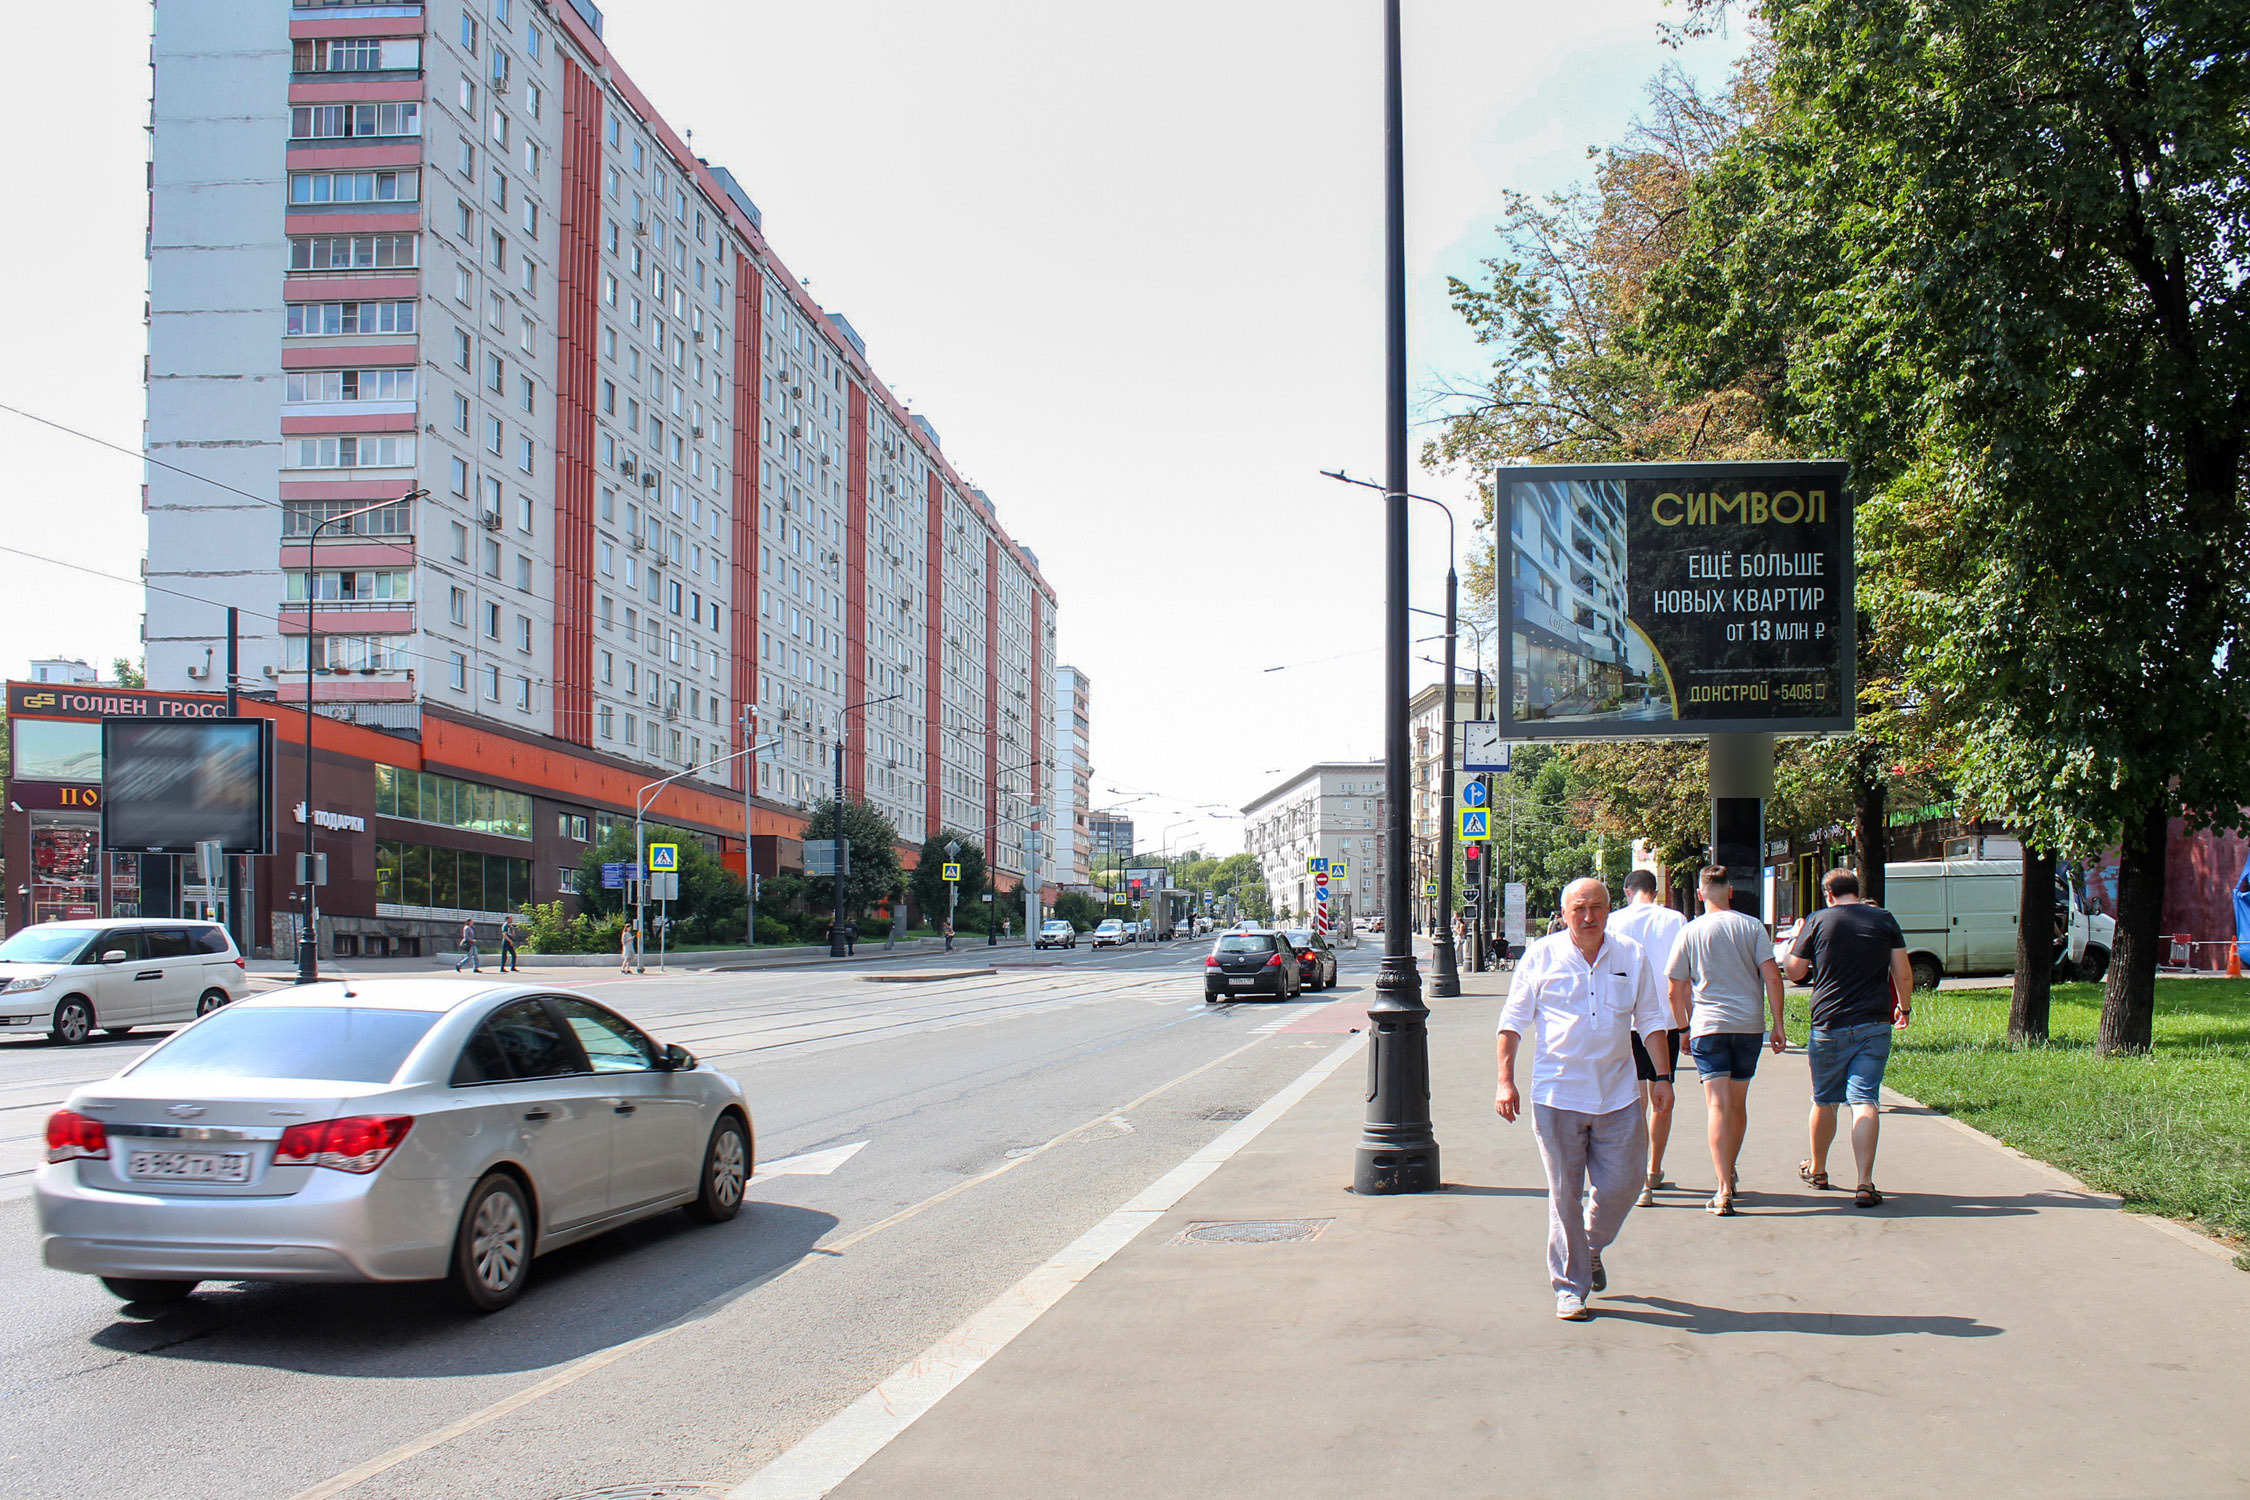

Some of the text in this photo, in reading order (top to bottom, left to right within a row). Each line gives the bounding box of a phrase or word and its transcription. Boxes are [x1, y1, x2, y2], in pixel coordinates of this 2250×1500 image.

[1651, 490, 1826, 527] СИМВОЛ
[1688, 551, 1825, 581] ЕЩЁ БОЛЬШЕ
[1654, 587, 1825, 614] НОВЫХ КВАРТИР
[1751, 619, 1771, 641] 13
[1689, 680, 1769, 702] ДОНСТРОЙ
[61, 694, 227, 718] ГОЛДЕН ГРОСС
[313, 810, 365, 832] ПОДАРКИ
